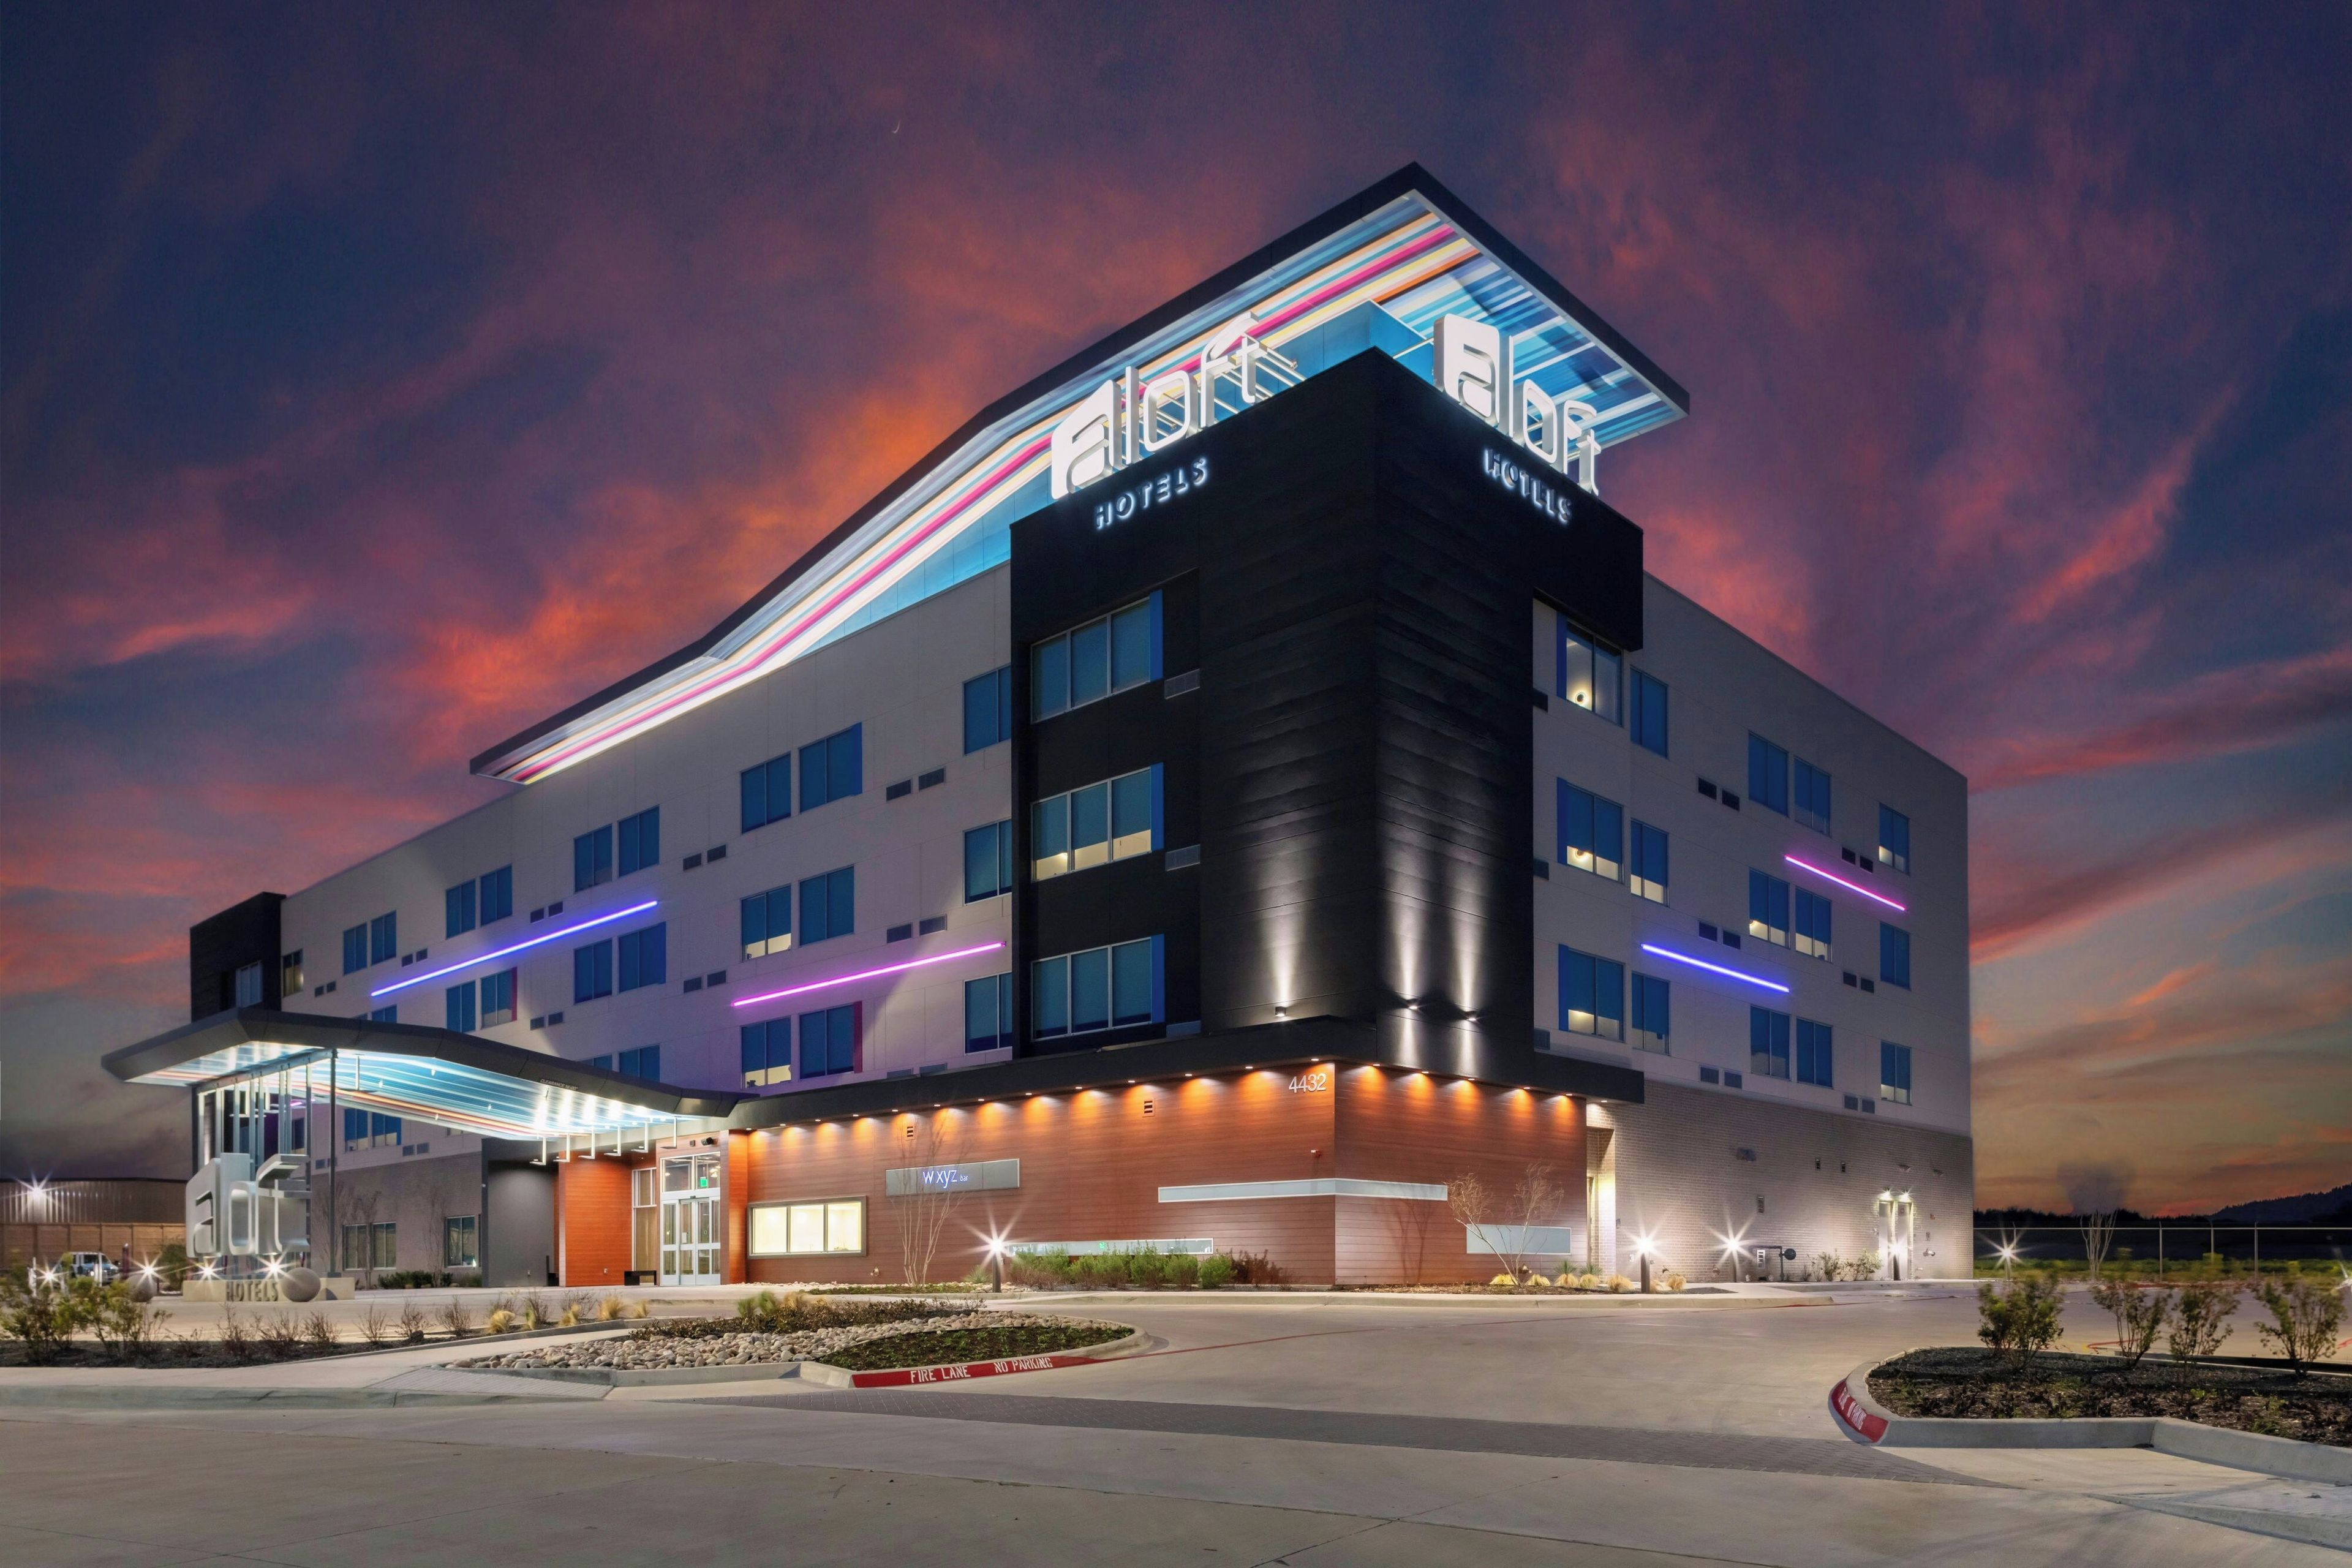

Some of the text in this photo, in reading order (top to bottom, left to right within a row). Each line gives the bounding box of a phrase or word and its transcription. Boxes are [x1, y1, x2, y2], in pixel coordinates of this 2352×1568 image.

[1051, 311, 1259, 499] aloft
[1434, 313, 1601, 496] aloft
[1095, 458, 1208, 530] HOTELS
[1288, 1072, 1326, 1093] 4432
[225, 1280, 279, 1302] HOTELS
[910, 1357, 1054, 1383] FIRE LANE NO PARKING
